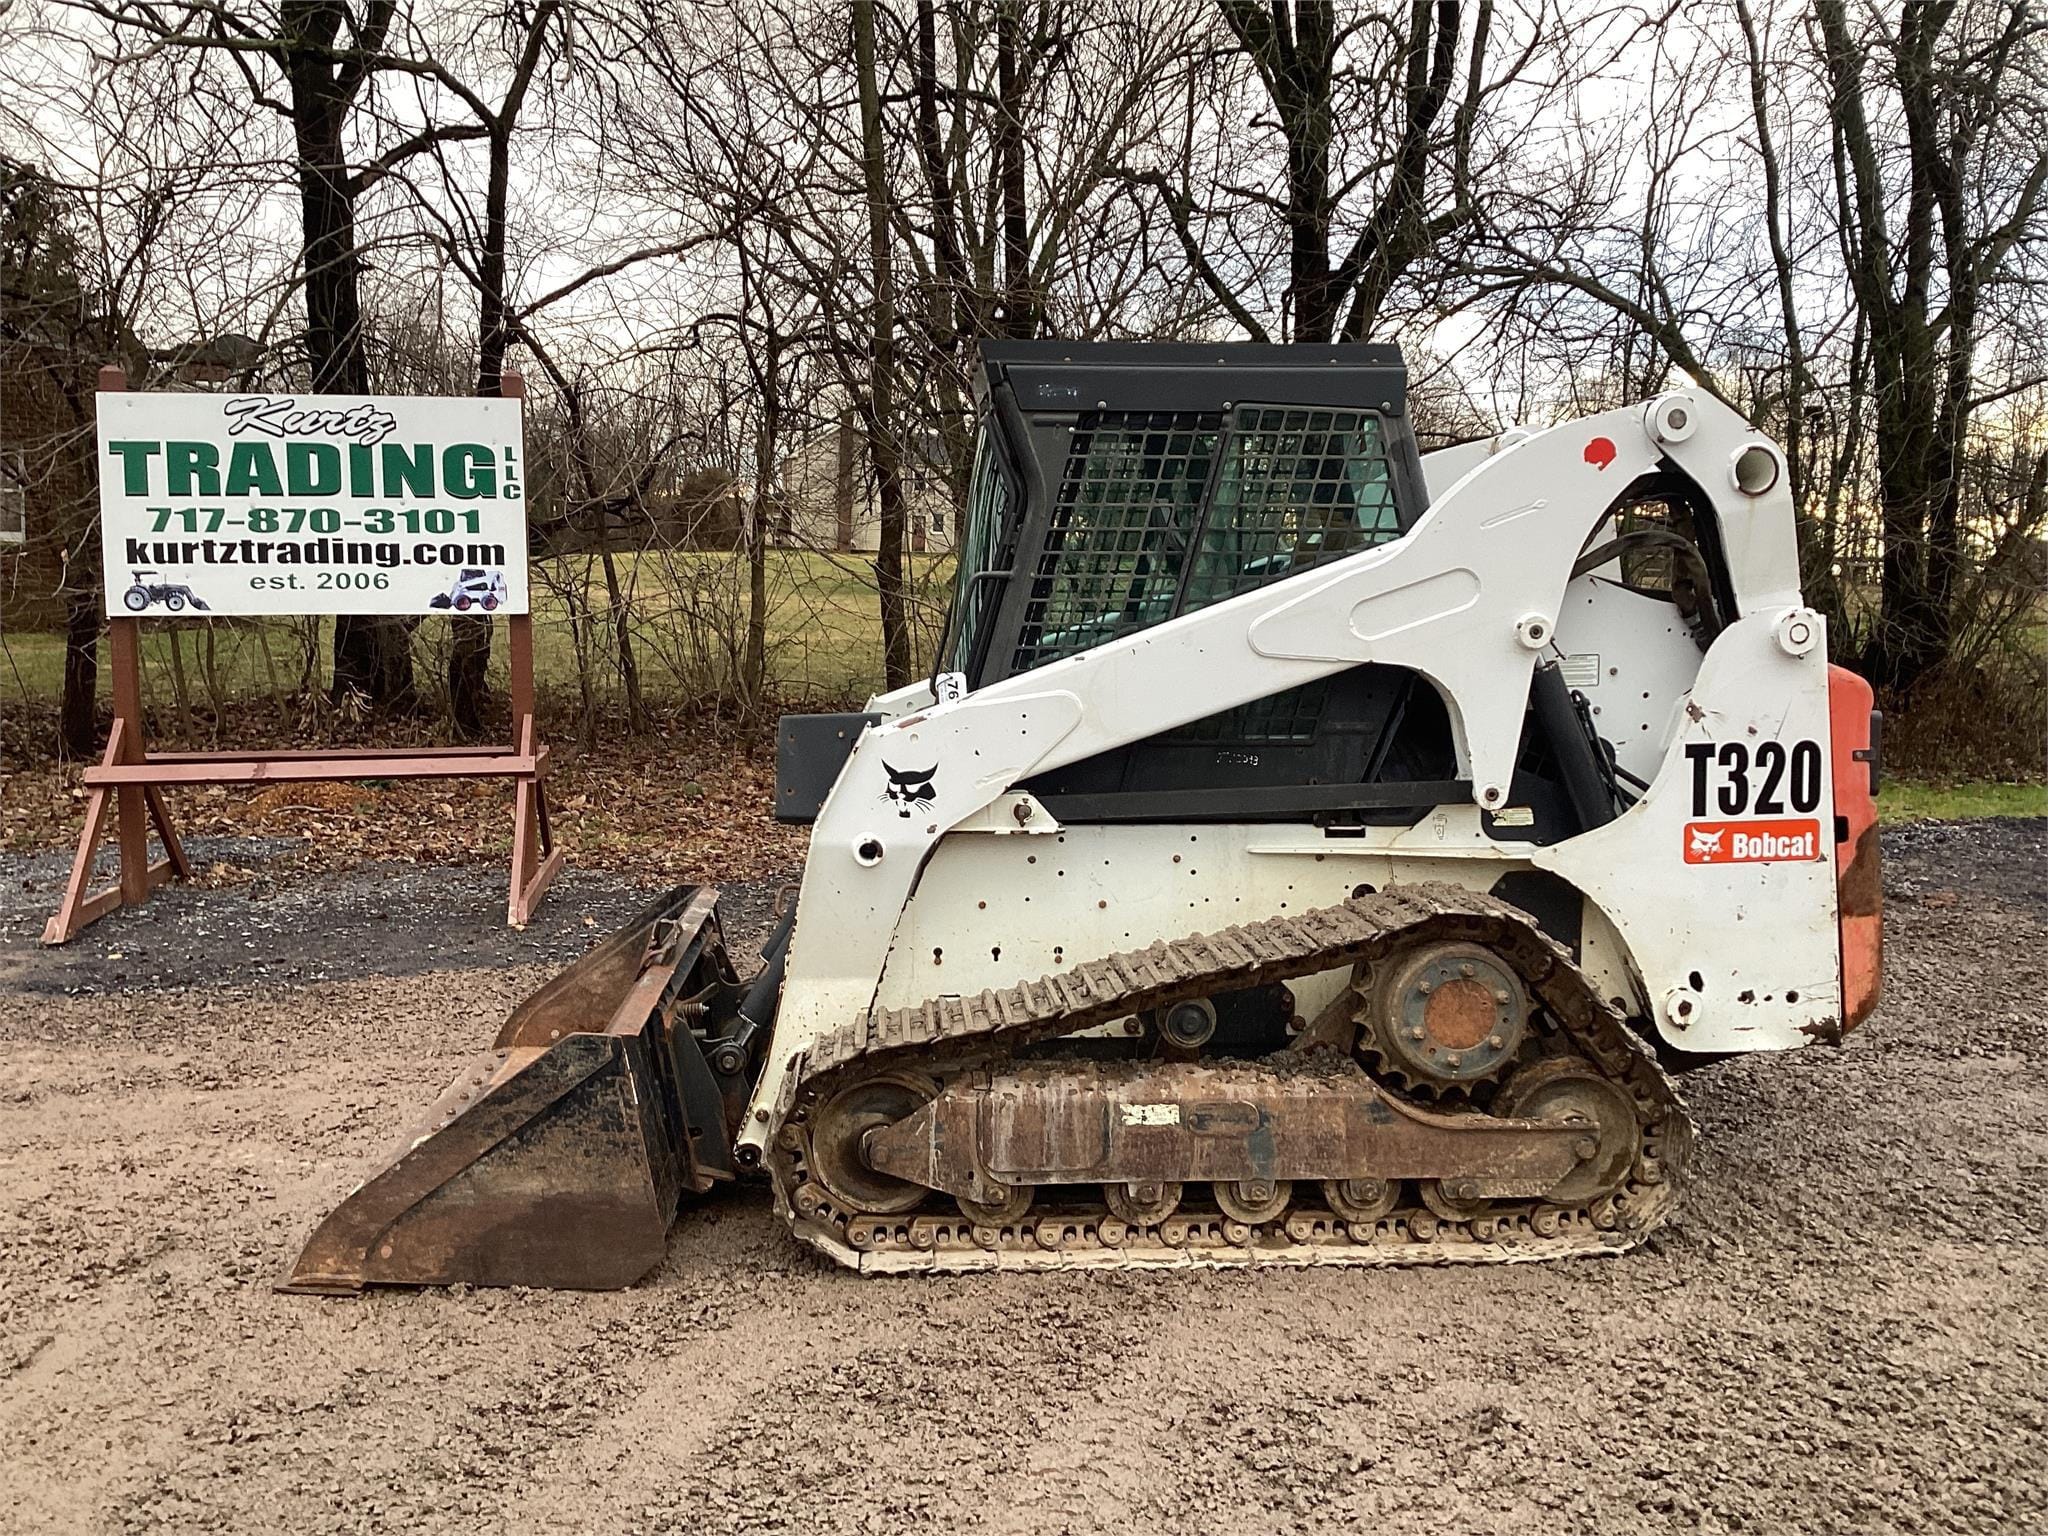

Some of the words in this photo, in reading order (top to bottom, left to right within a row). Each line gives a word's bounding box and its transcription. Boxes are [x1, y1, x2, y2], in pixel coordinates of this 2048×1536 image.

[224, 397, 396, 446] Kurtz
[108, 440, 497, 499] TRADING
[503, 446, 521, 500] LLC
[146, 507, 480, 534] 717-870-3101
[125, 537, 505, 568] kurtztrading.com
[250, 574, 305, 590] est.
[316, 573, 390, 590] 2006
[947, 680, 960, 703] 76
[1685, 740, 1822, 817] T320
[1732, 832, 1814, 859] Bobcat
